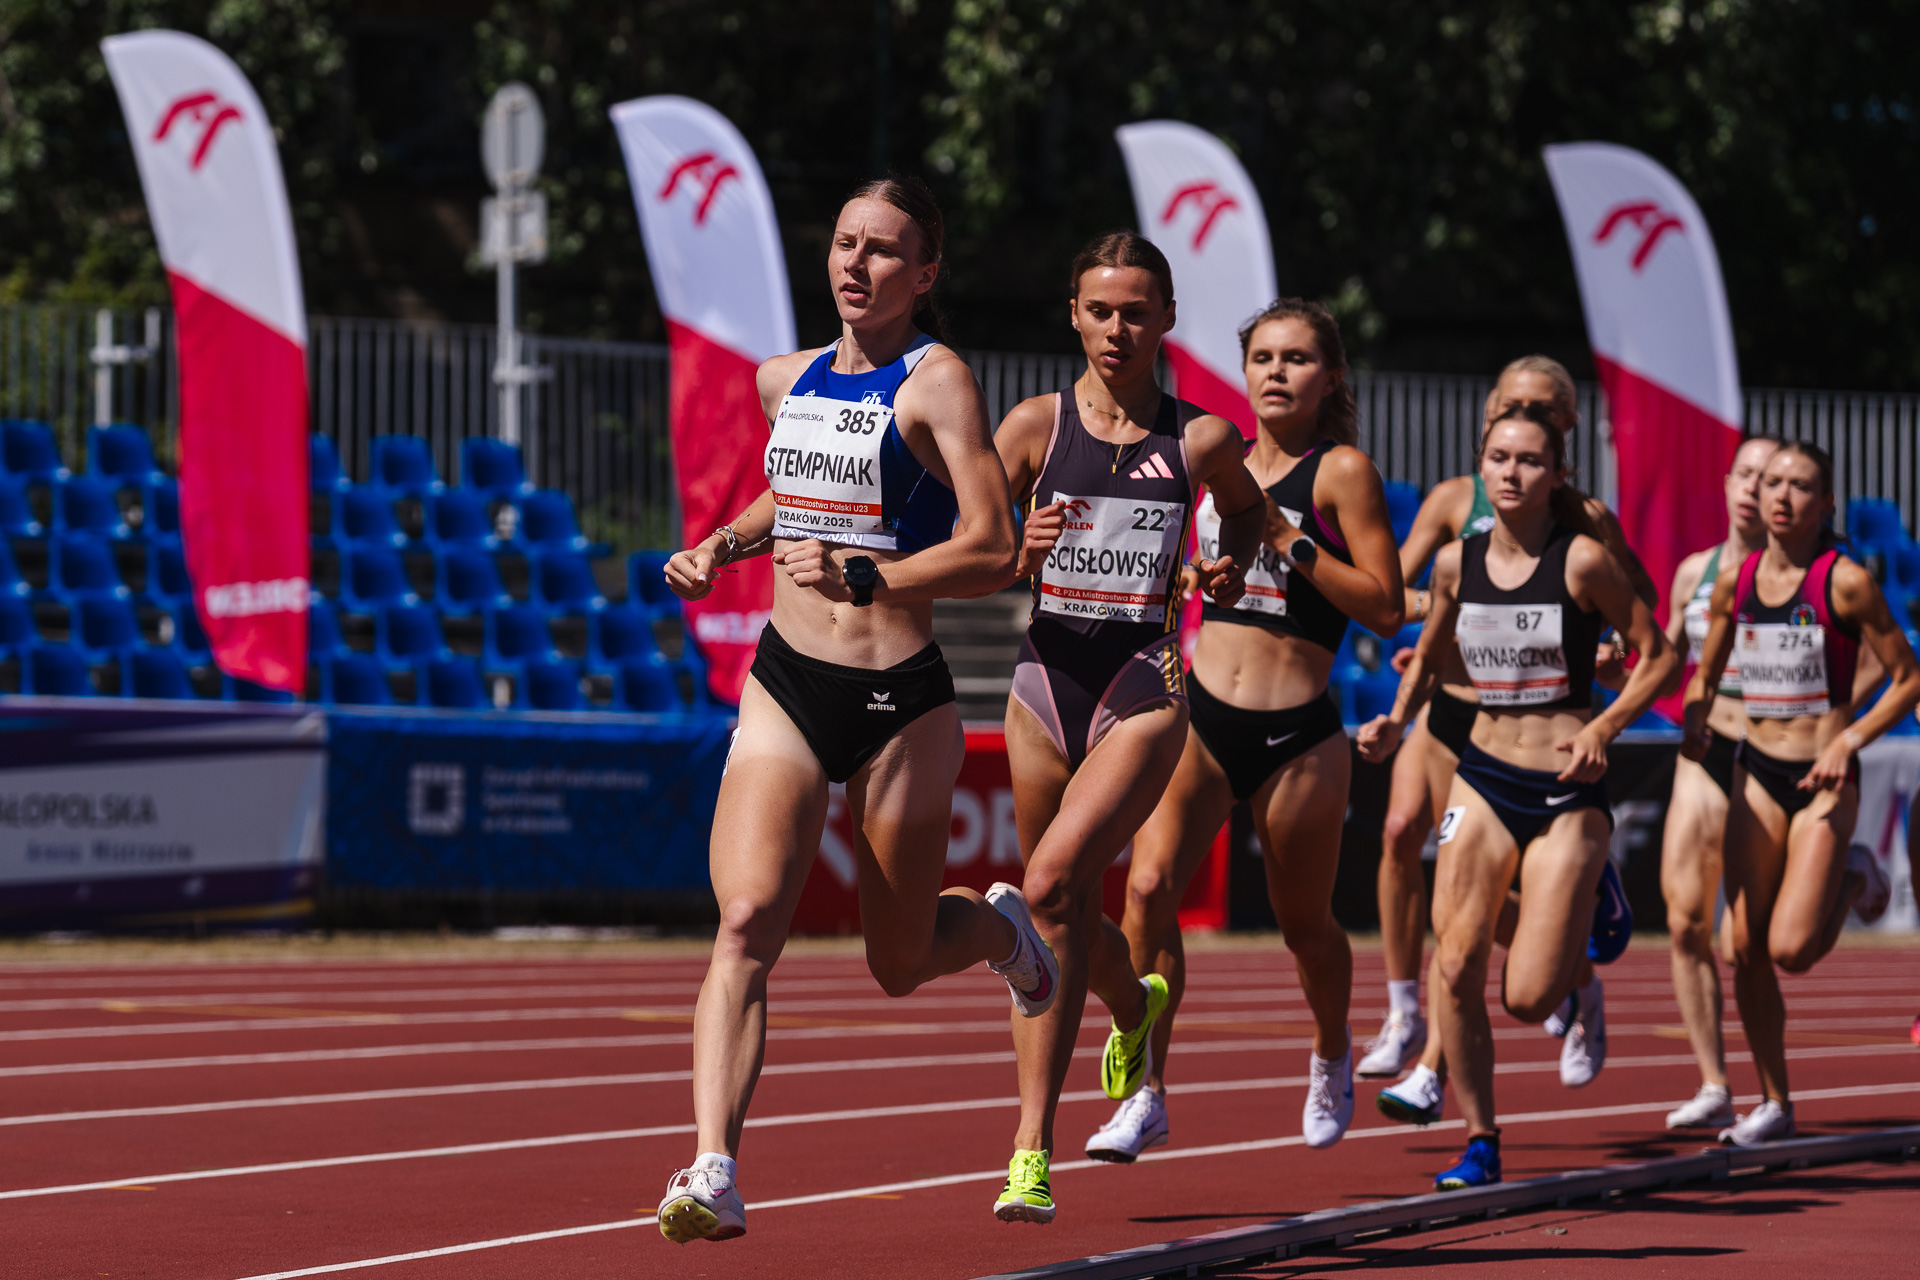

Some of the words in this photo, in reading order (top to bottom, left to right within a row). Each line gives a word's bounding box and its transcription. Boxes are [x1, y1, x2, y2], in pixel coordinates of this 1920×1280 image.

[835, 408, 879, 436] 385
[767, 446, 874, 487] STEMPNIAK
[792, 496, 829, 510] Mistrzostwa
[829, 501, 852, 513] Polski
[852, 504, 869, 514] U23
[778, 509, 822, 526] KRAKÓW
[823, 515, 854, 529] 2025
[1131, 507, 1166, 532] 22
[1063, 588, 1082, 598] PZLA
[1082, 590, 1130, 604] Mistrzostwa
[1063, 601, 1120, 618] KRAKÓW
[1515, 610, 1544, 632] 87
[1777, 631, 1815, 651] 274
[1463, 645, 1564, 669] MŁYNARCZYK
[866, 702, 897, 712] erima
